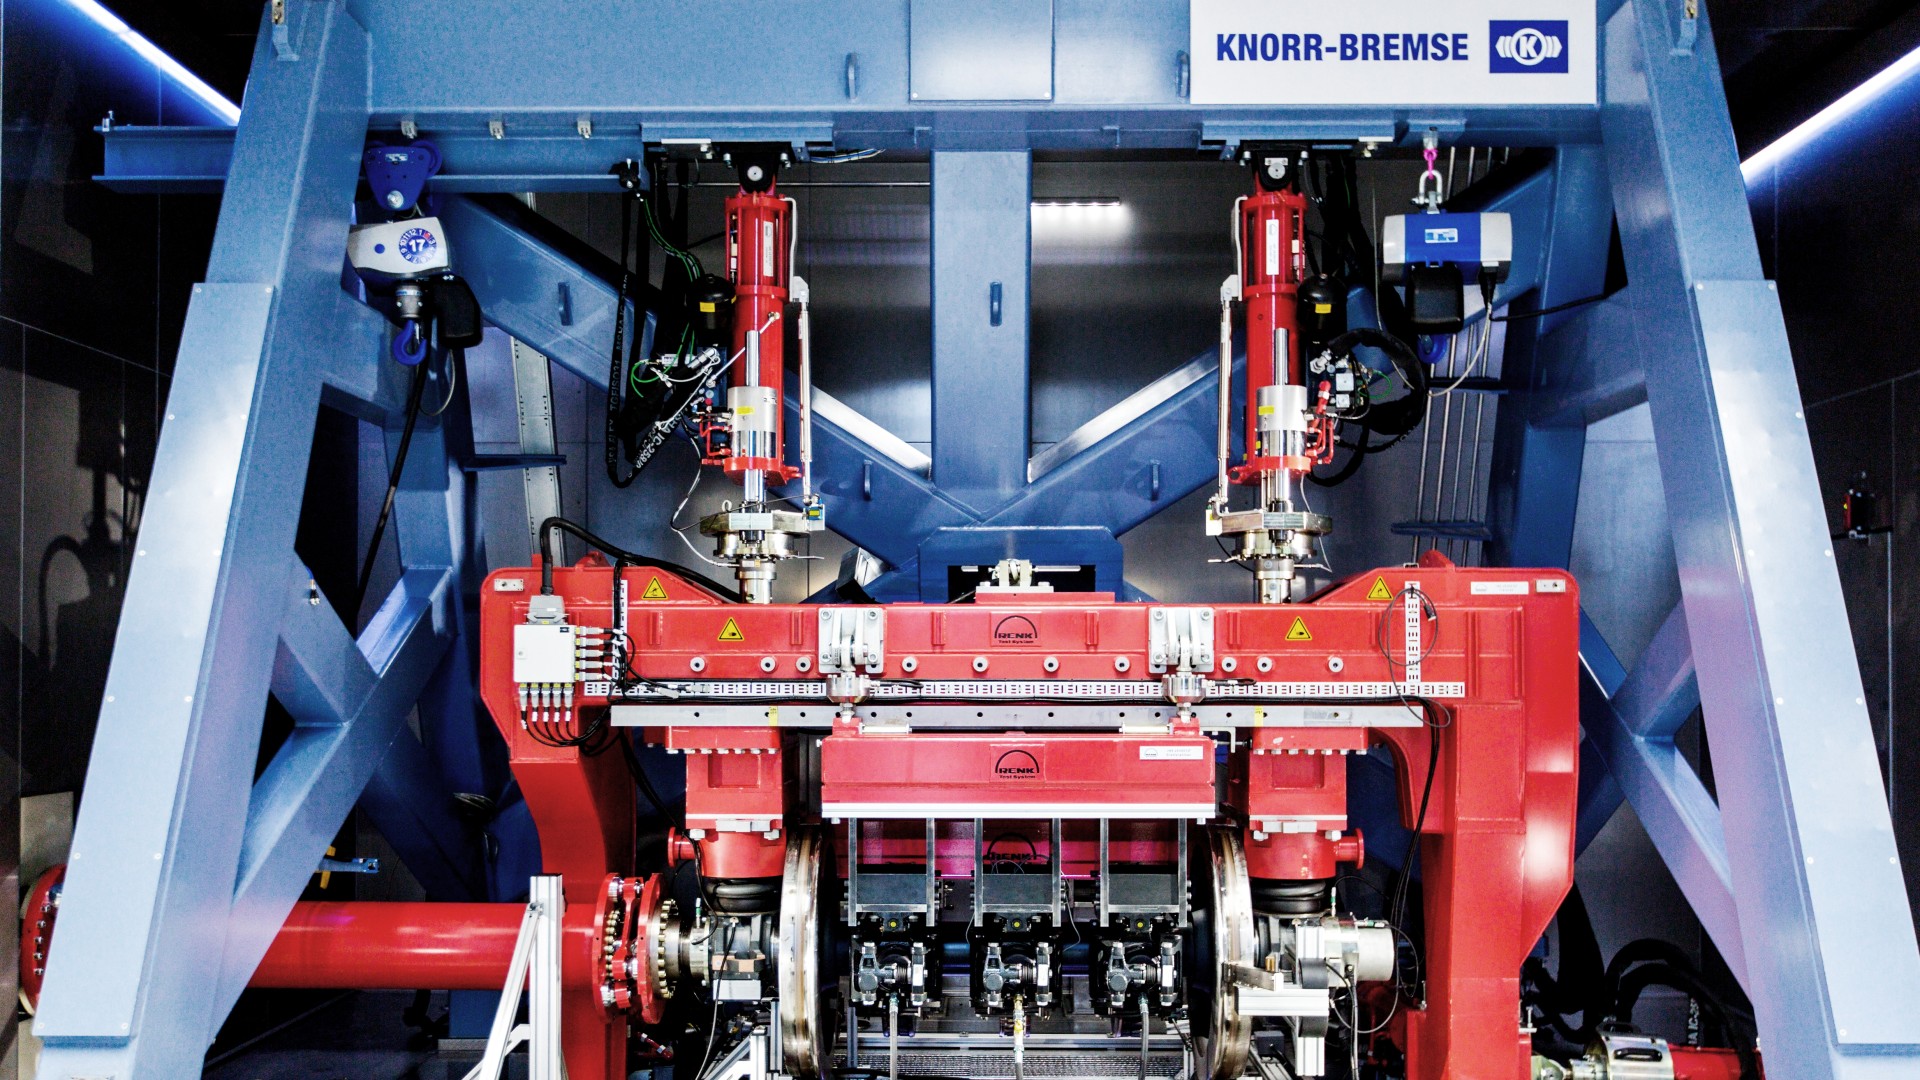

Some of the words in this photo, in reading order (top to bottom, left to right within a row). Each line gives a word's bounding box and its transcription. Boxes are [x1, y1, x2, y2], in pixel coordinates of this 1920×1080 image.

[1217, 33, 1469, 61] KNORR-BREMSE
[1520, 35, 1538, 58] K
[409, 239, 426, 252] 17
